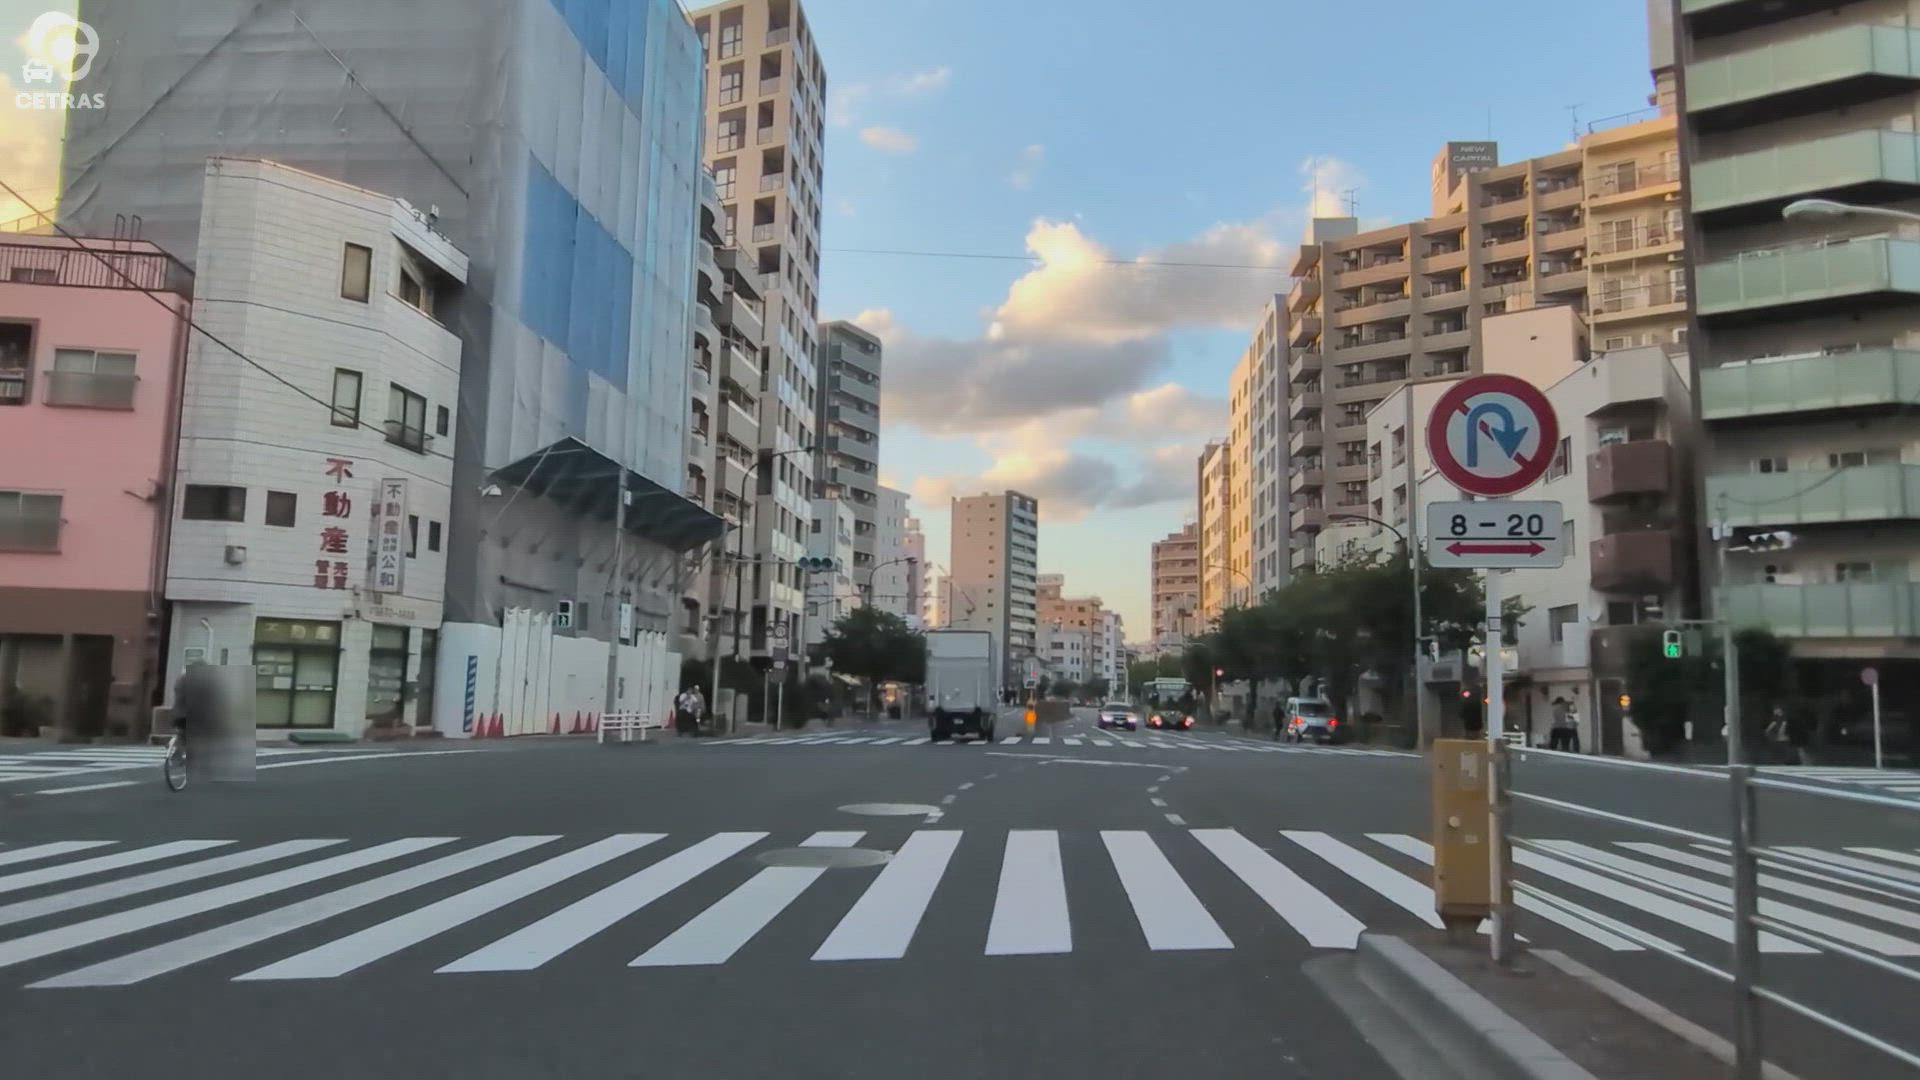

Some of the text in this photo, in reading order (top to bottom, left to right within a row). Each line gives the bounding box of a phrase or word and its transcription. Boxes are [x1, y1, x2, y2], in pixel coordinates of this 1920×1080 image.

[1460, 145, 1487, 153] NEW
[320, 458, 354, 553] 不動産
